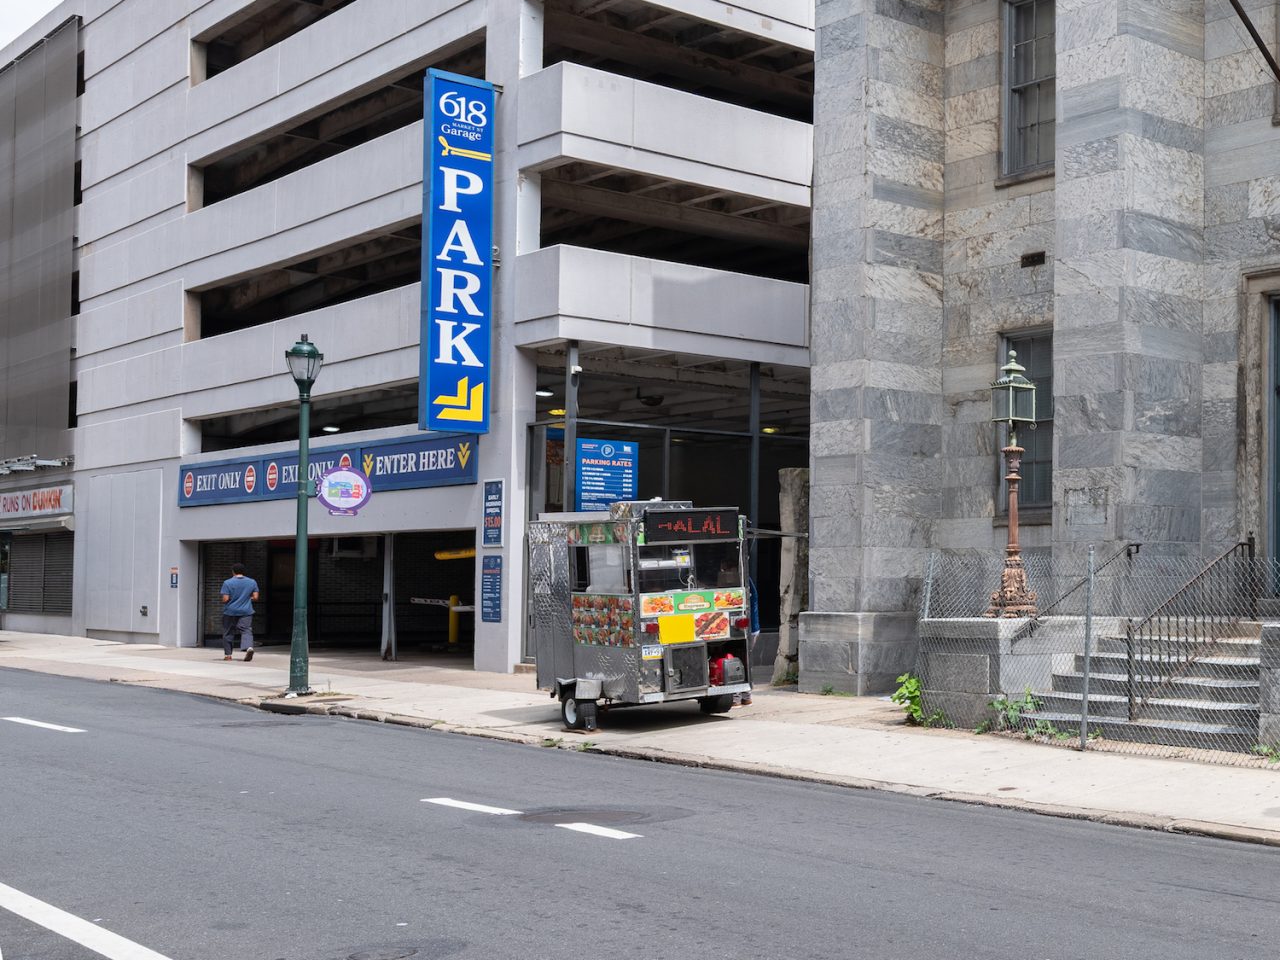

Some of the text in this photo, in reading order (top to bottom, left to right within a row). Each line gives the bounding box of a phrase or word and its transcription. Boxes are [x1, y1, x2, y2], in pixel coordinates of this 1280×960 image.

[438, 91, 487, 127] 618
[441, 124, 482, 141] Garage
[452, 122, 475, 131] MARKET
[434, 166, 484, 367] PARK
[375, 452, 417, 476] ENTER
[419, 448, 456, 472] HERE
[582, 458, 610, 466] PARKING
[196, 473, 217, 492] EXIT
[218, 471, 242, 490] ONLY
[282, 464, 299, 484] EXI
[3, 495, 20, 513] RUNS
[21, 494, 31, 511] ON
